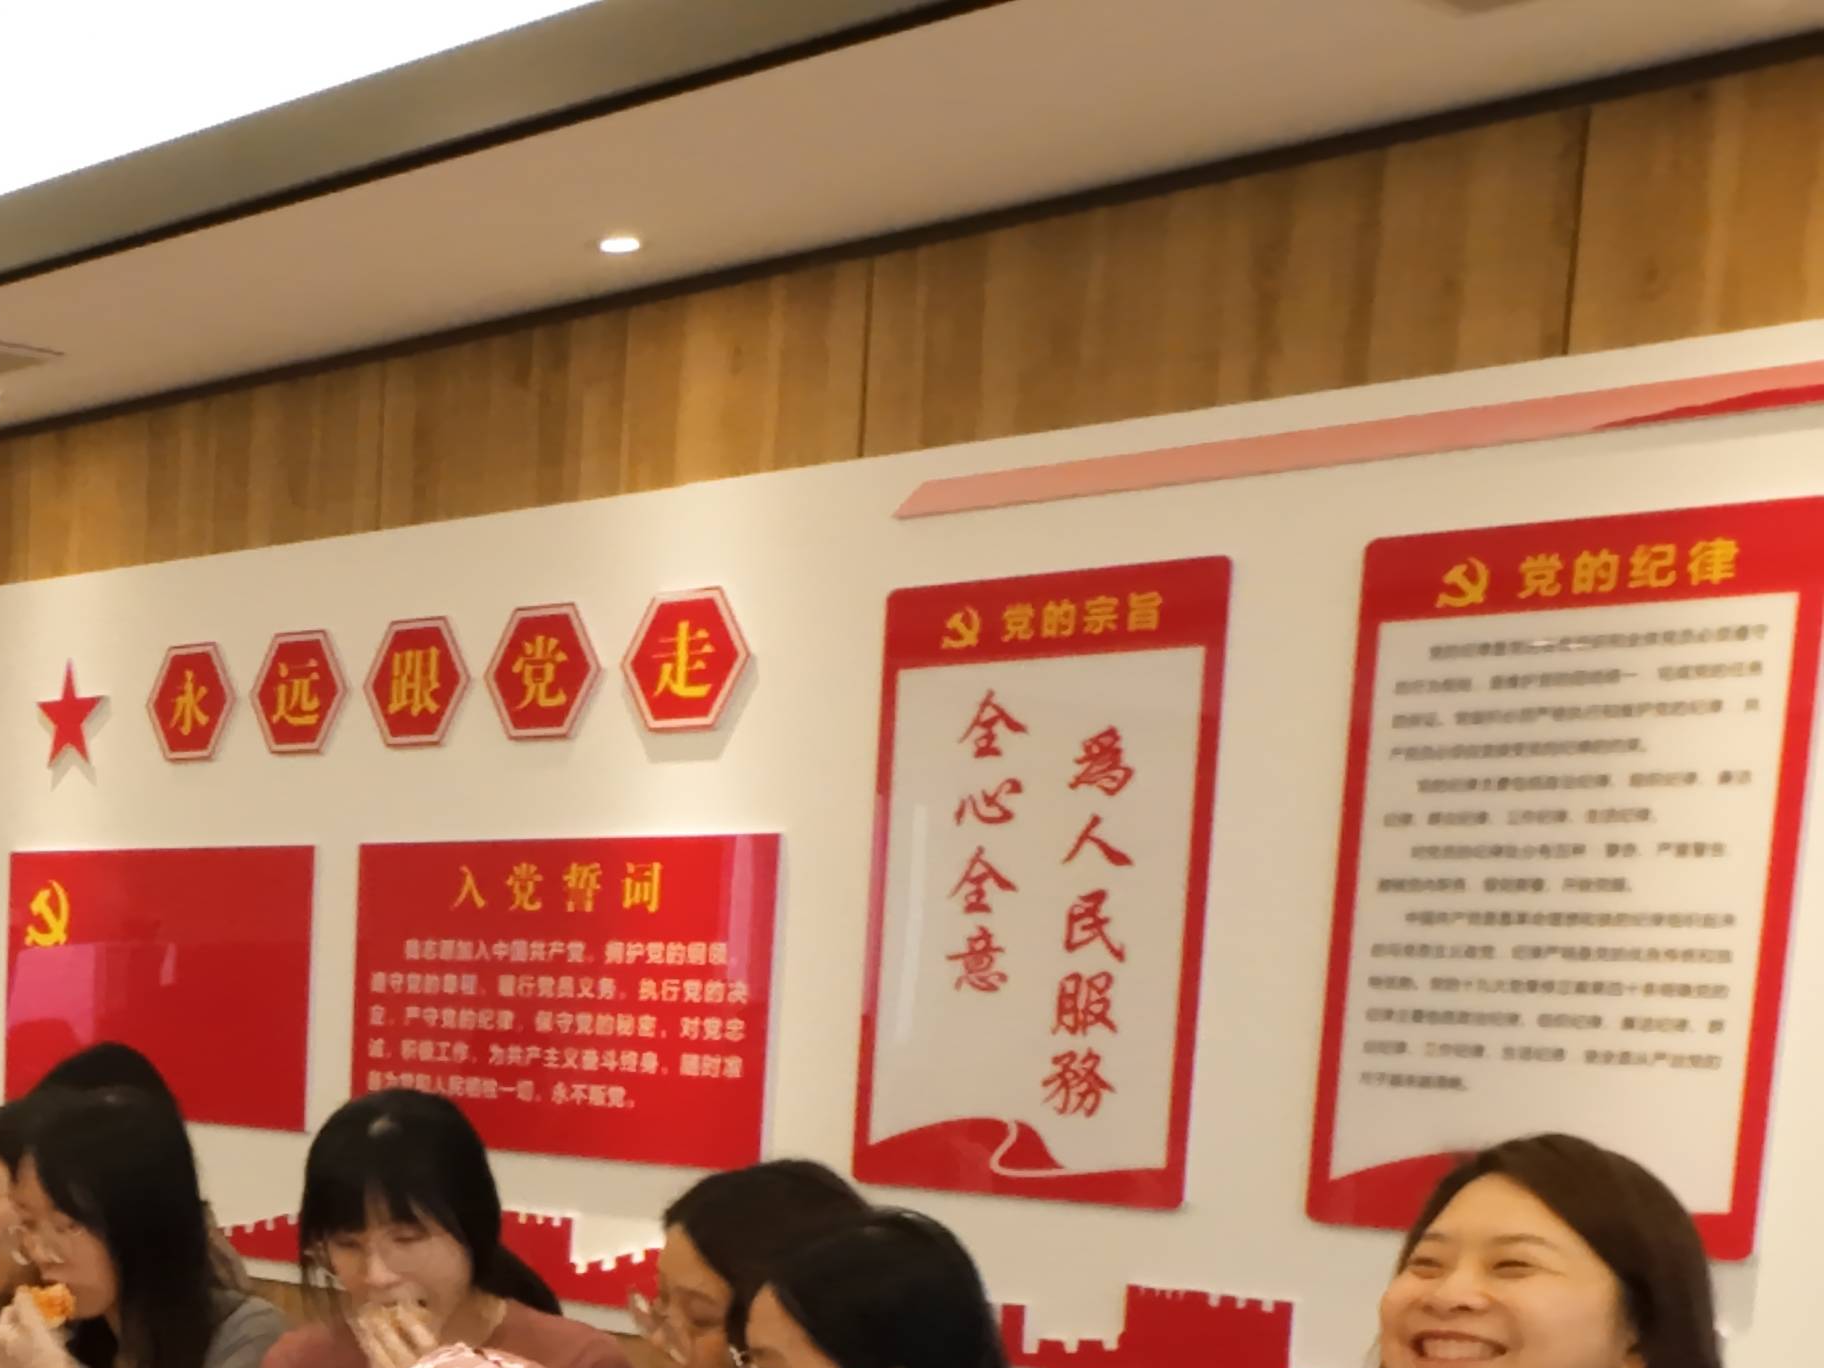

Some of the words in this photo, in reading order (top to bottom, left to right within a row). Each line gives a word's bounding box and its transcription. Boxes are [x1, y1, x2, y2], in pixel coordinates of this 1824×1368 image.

[1518, 538, 1740, 598] 党的纪律
[1002, 592, 1163, 641] 党的宗旨
[169, 620, 712, 734] 永远跟党走
[947, 690, 1028, 993] 全心全意
[450, 862, 662, 912] 入党誓词
